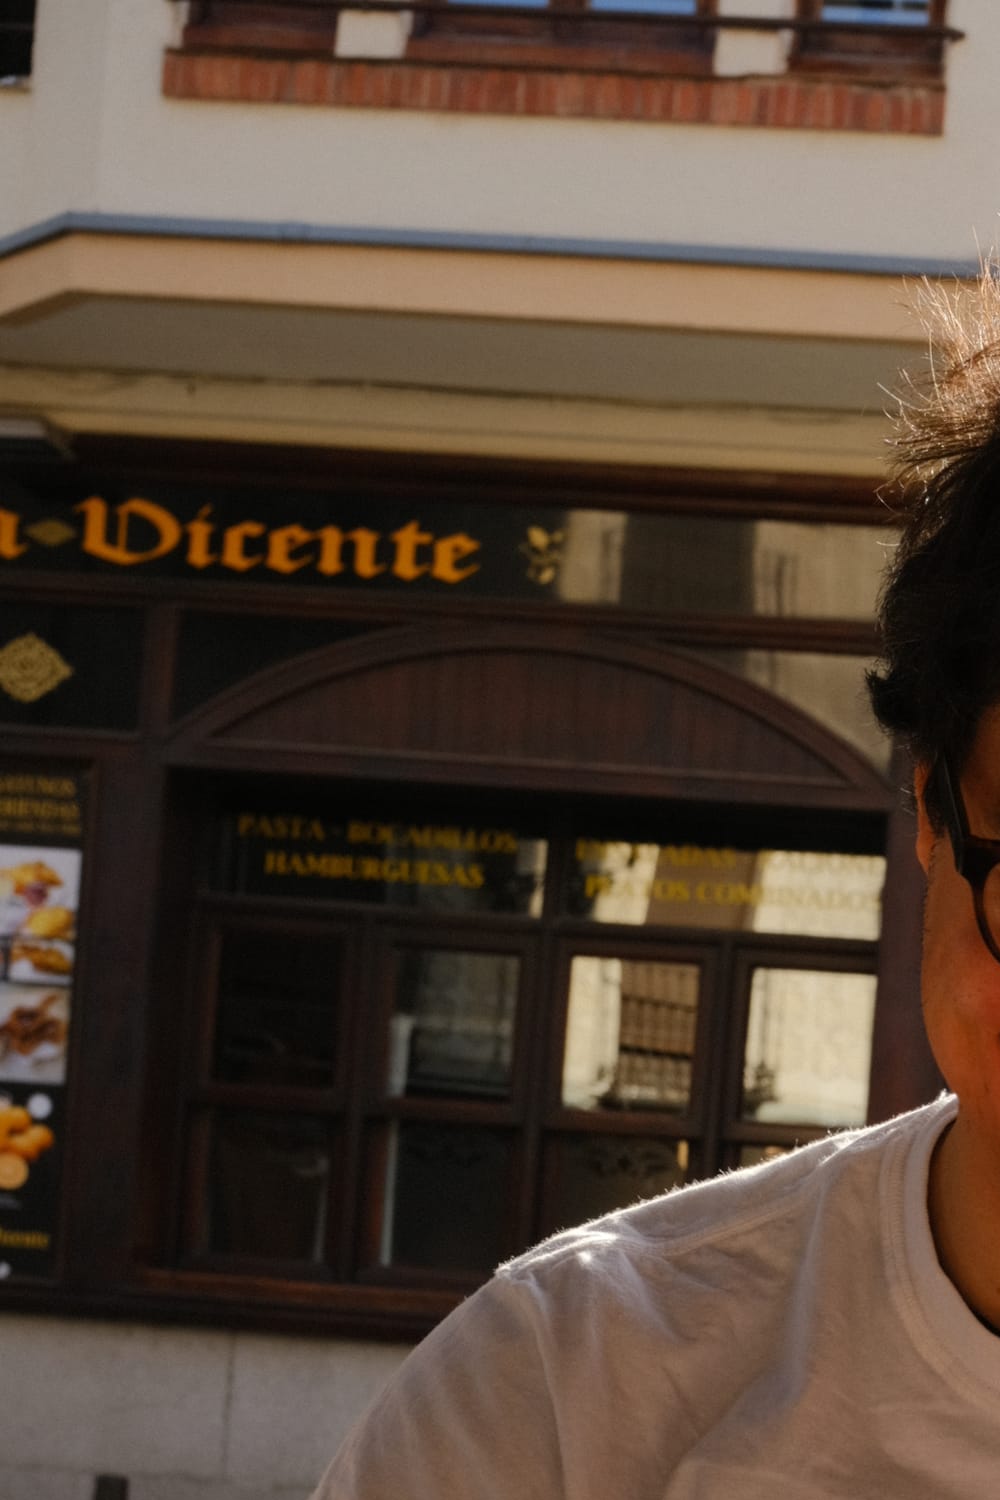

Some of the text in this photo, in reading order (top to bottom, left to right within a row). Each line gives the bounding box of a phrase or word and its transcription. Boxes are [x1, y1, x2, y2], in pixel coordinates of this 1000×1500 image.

[75, 496, 481, 584] Vicente
[237, 812, 326, 842] PASTA
[346, 819, 518, 855] BOCADILLOS
[263, 850, 486, 889] HAMBURGUESAS
